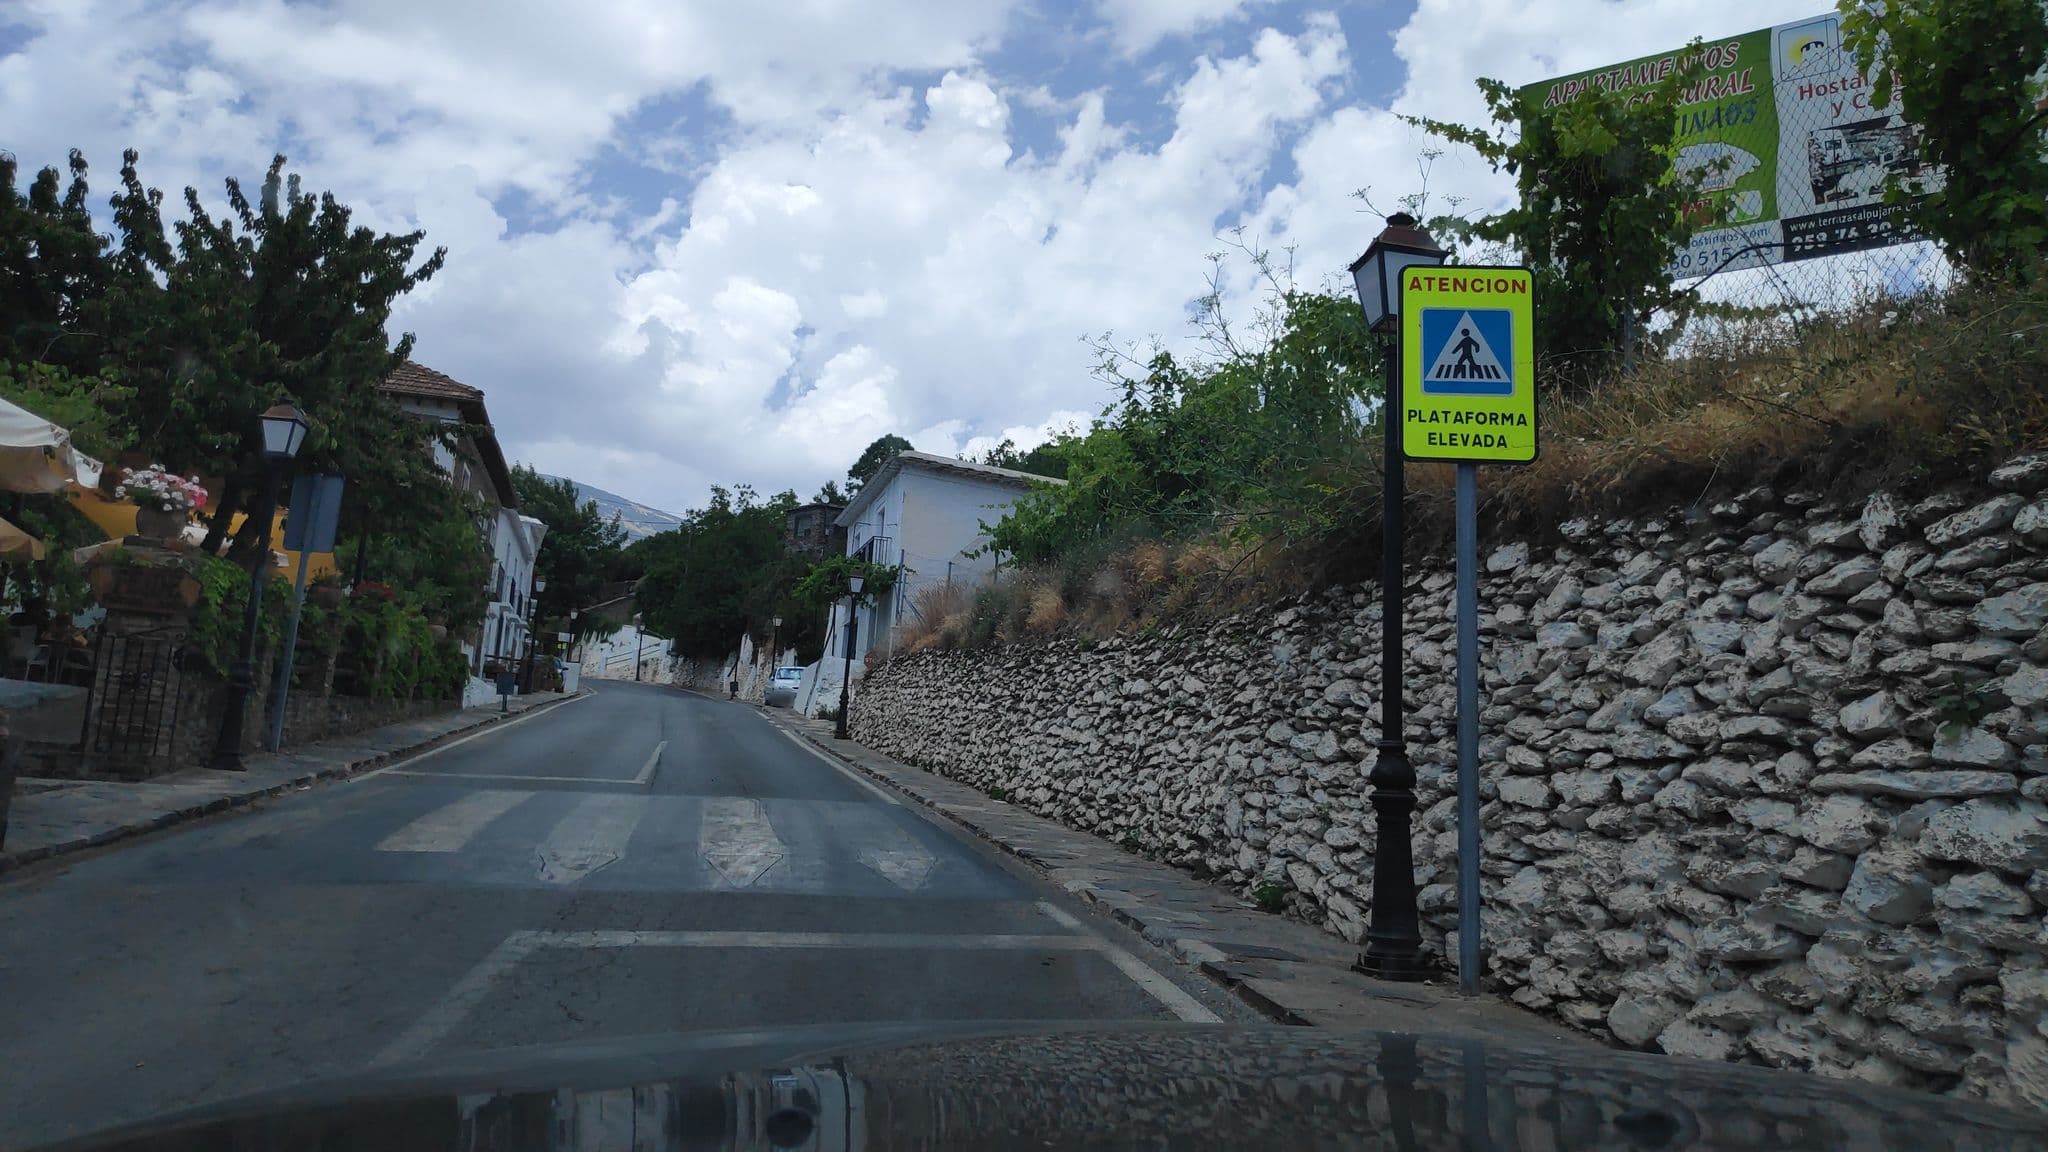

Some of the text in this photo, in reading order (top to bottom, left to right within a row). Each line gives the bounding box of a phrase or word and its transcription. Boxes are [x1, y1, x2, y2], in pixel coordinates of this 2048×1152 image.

[1680, 95, 1757, 137] INAOS
[1408, 276, 1527, 294] ATENCION
[1407, 409, 1528, 427] PLATAFORMA
[1427, 432, 1508, 449] ELEVADA
